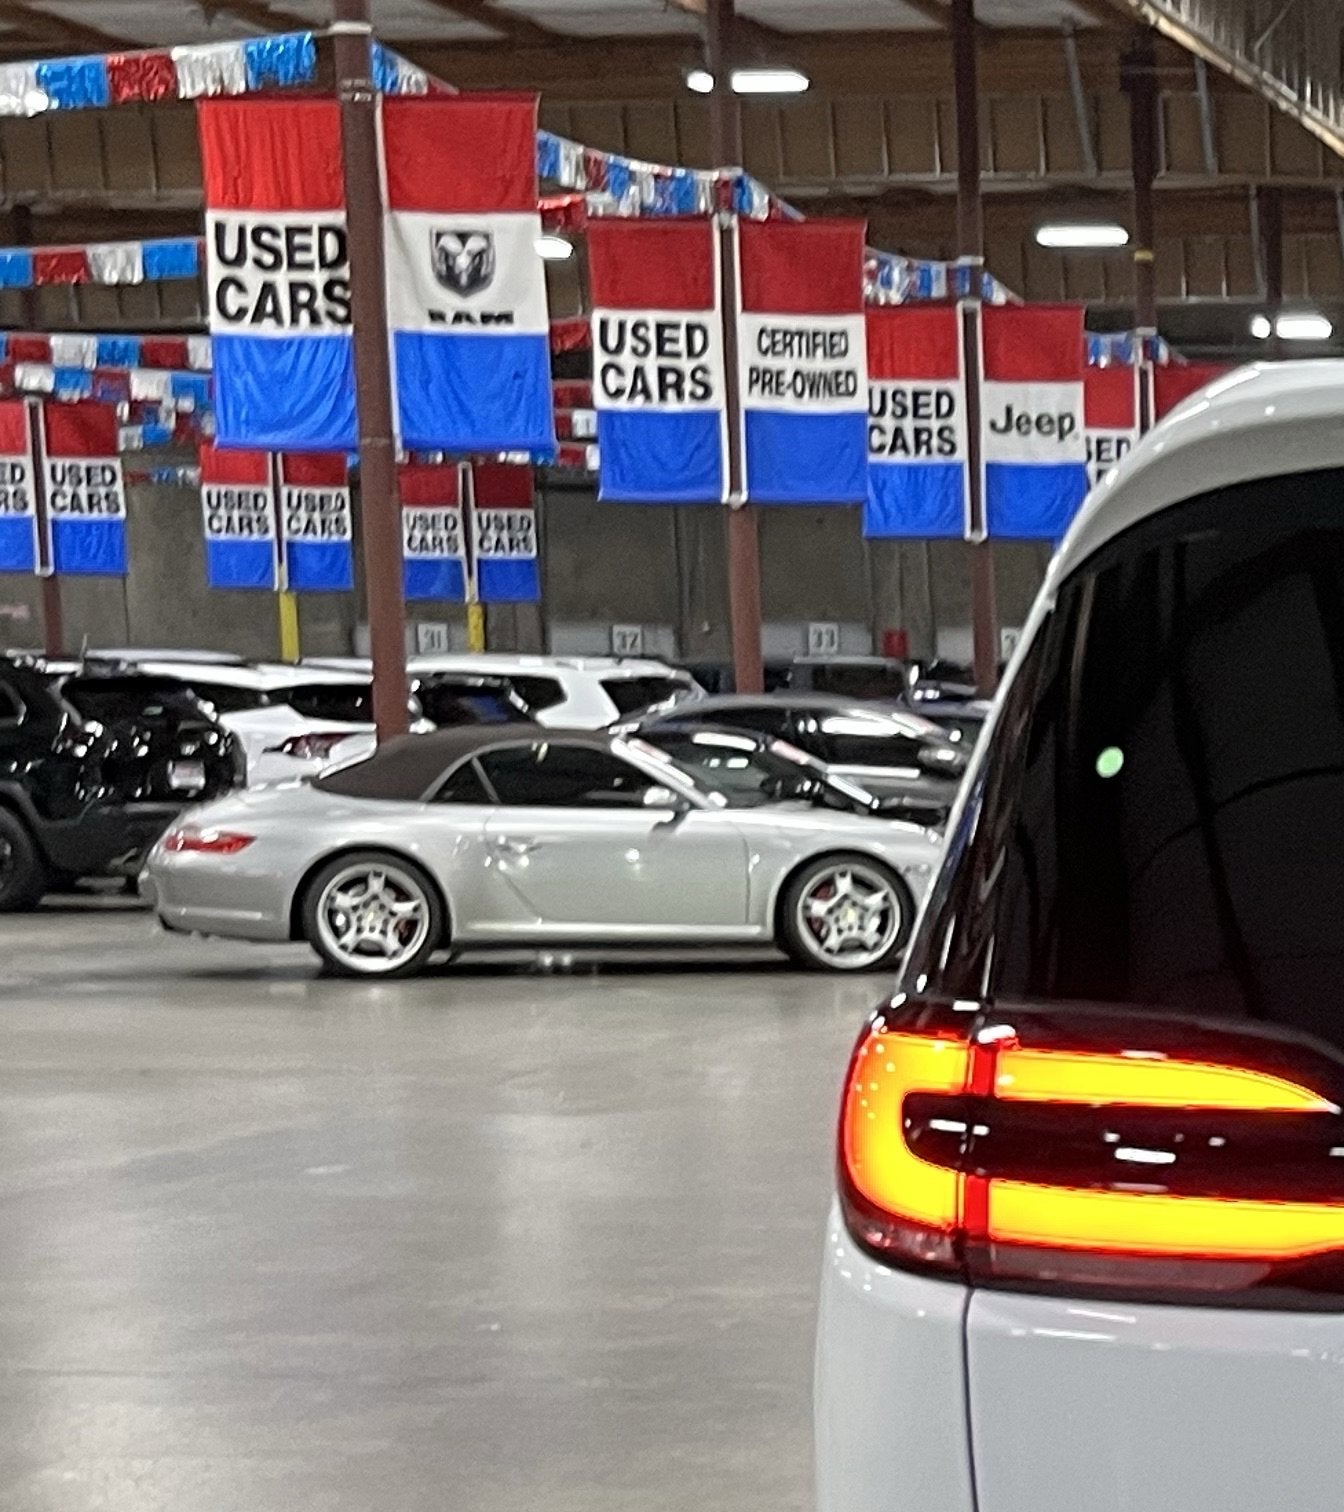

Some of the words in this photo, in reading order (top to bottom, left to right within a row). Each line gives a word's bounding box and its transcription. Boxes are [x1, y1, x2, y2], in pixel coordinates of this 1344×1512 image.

[214, 221, 347, 272] USED
[214, 276, 351, 327] CARS
[600, 318, 709, 358] USED
[757, 326, 849, 359] CERTIFIED
[600, 362, 713, 403] CARS
[749, 365, 858, 398] PRE-OWNED
[868, 387, 955, 420] USED
[989, 404, 1076, 442] Jeep
[868, 425, 957, 457] CARS
[50, 462, 118, 487] USED
[50, 489, 121, 514] CARS
[206, 489, 268, 513] USED
[286, 492, 346, 513] USED
[207, 513, 270, 536] CARS
[287, 515, 347, 537] CARS
[406, 512, 458, 532] USED
[477, 512, 532, 533] USED
[407, 534, 459, 553] CARS
[478, 534, 533, 554] CARS
